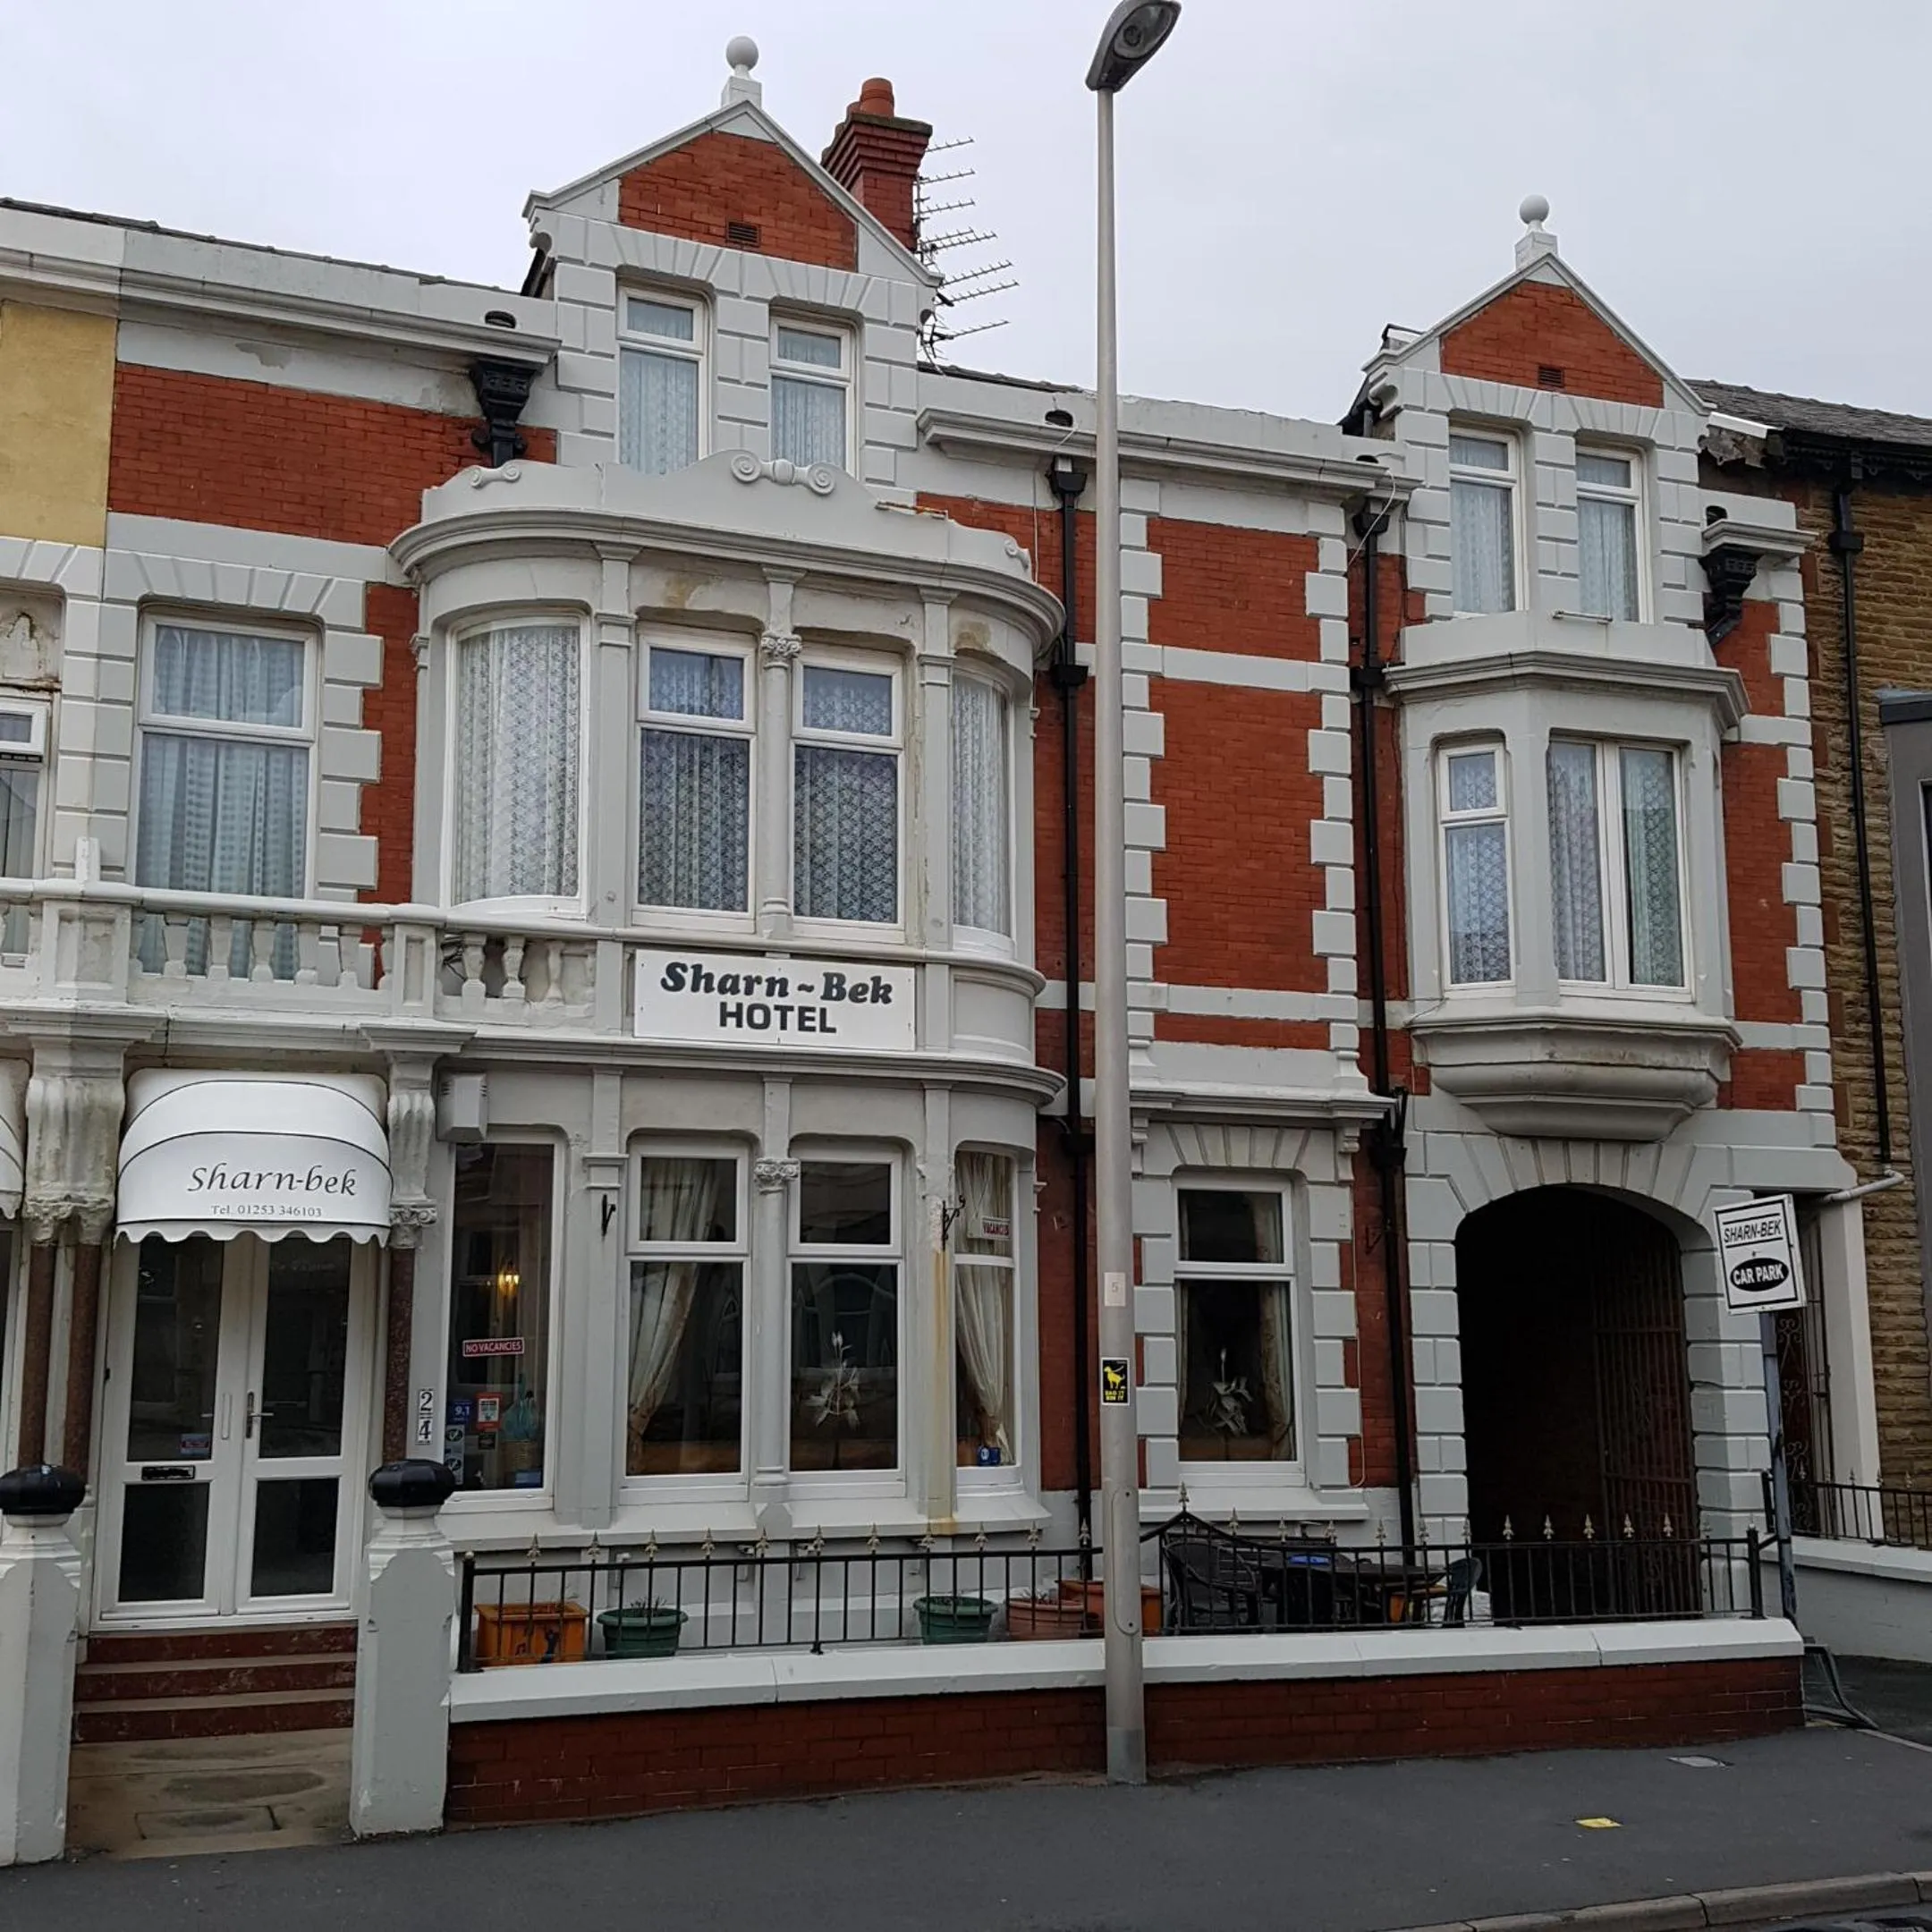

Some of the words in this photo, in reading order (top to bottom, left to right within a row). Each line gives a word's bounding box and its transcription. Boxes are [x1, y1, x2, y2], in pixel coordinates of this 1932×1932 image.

[719, 1002, 837, 1034] HOTEL
[187, 1162, 357, 1196] Sharn-bek
[237, 1205, 275, 1216] 01253
[278, 1205, 322, 1217] 346103
[1724, 1219, 1782, 1242] SHARN-BEK
[1733, 1267, 1755, 1285] CAR
[1755, 1264, 1785, 1283] PARK
[465, 1343, 479, 1353] NO
[479, 1341, 521, 1353] VACANCIES
[454, 1405, 470, 1416] 9.1
